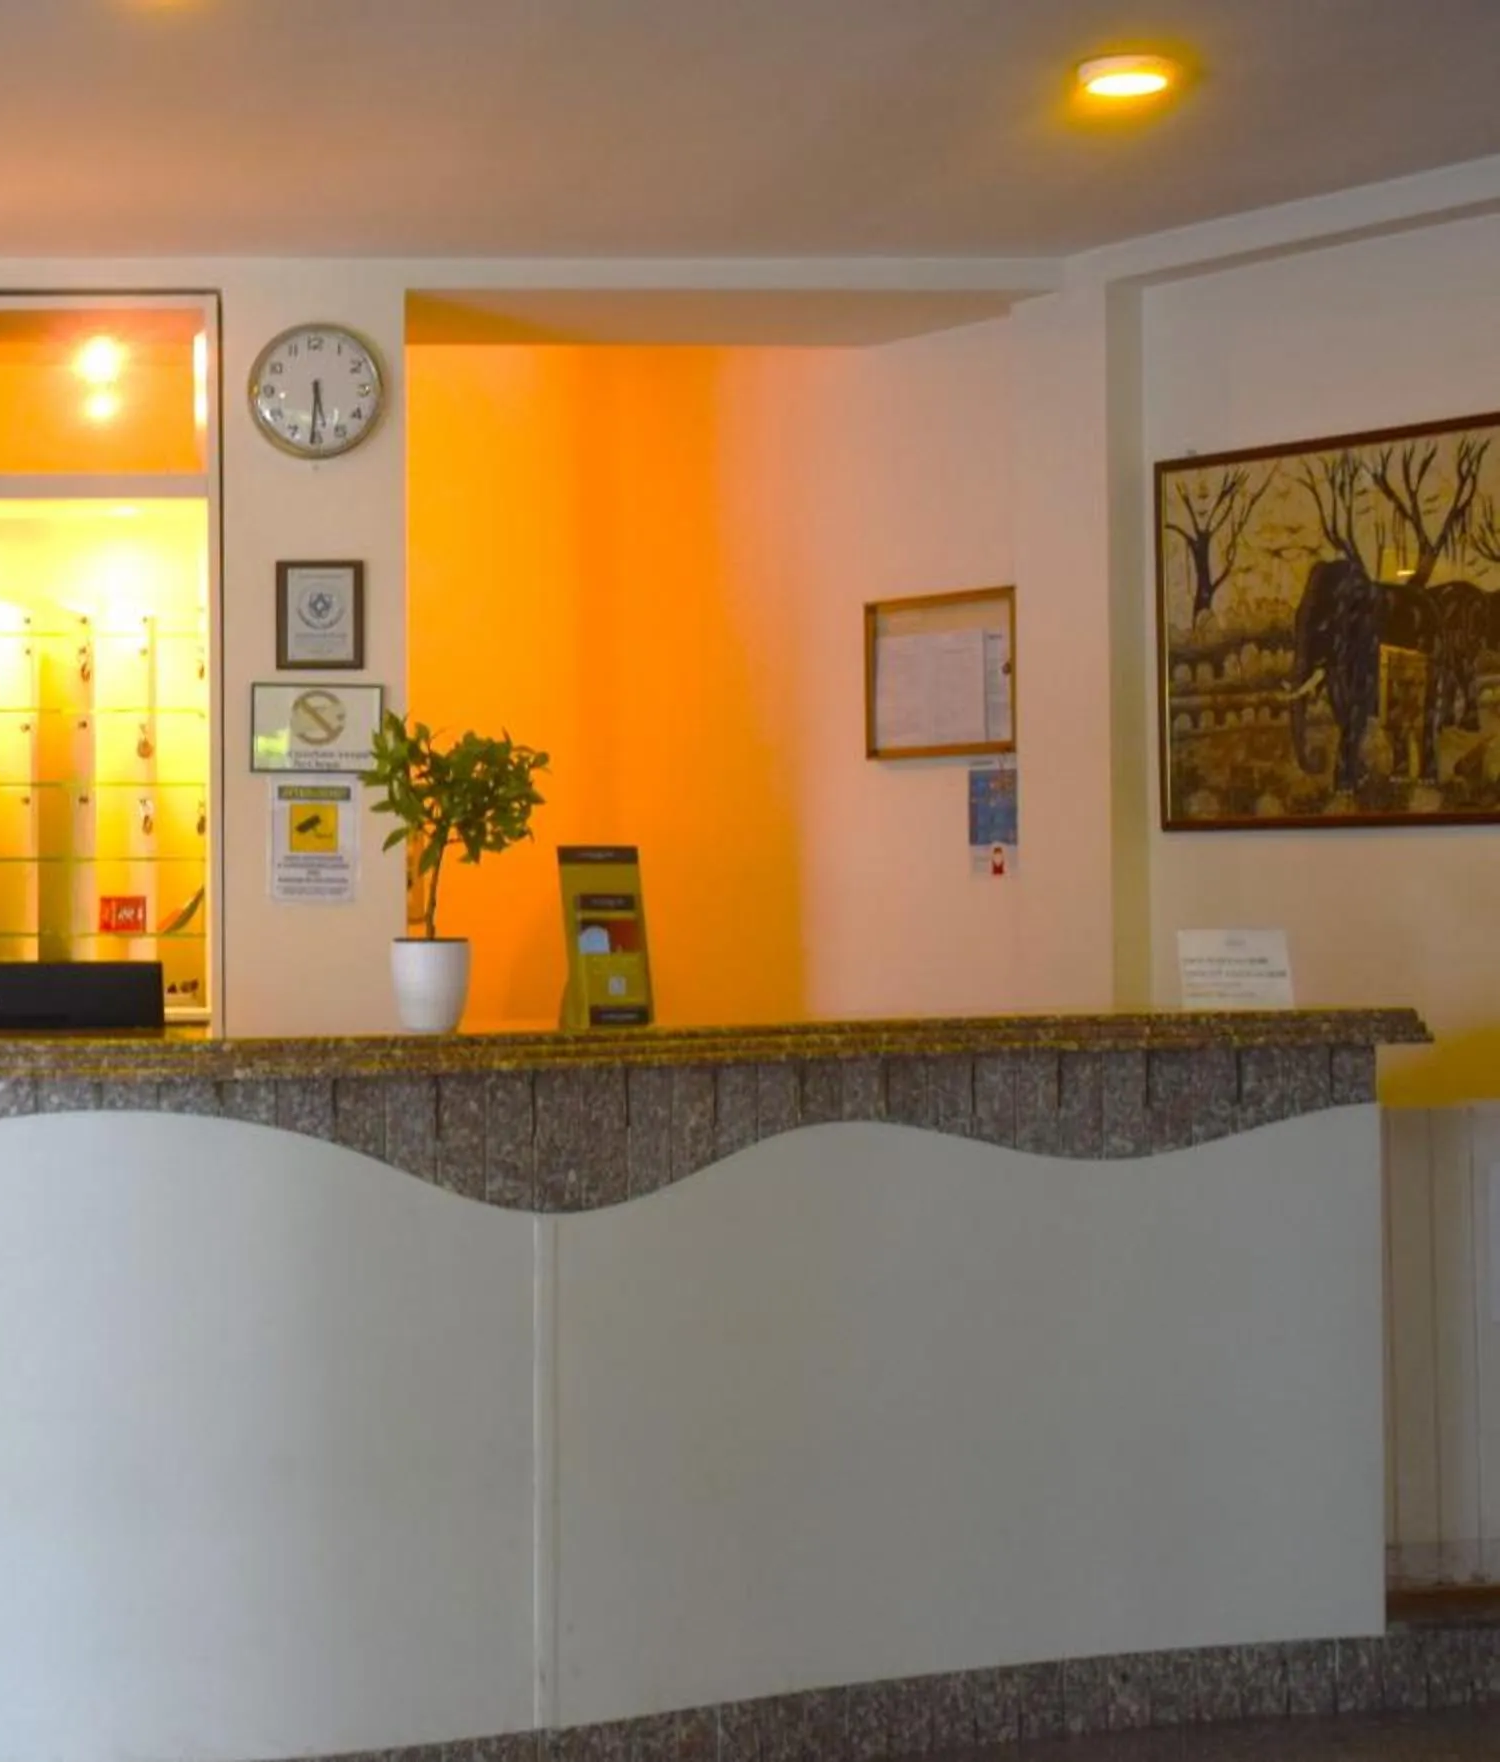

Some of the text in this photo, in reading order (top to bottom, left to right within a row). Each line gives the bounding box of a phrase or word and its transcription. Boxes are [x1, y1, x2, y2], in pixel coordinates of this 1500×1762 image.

[306, 336, 324, 351] 12
[269, 361, 283, 374] 10
[350, 358, 362, 374] 2
[350, 406, 362, 420] 4
[287, 423, 299, 438] 7
